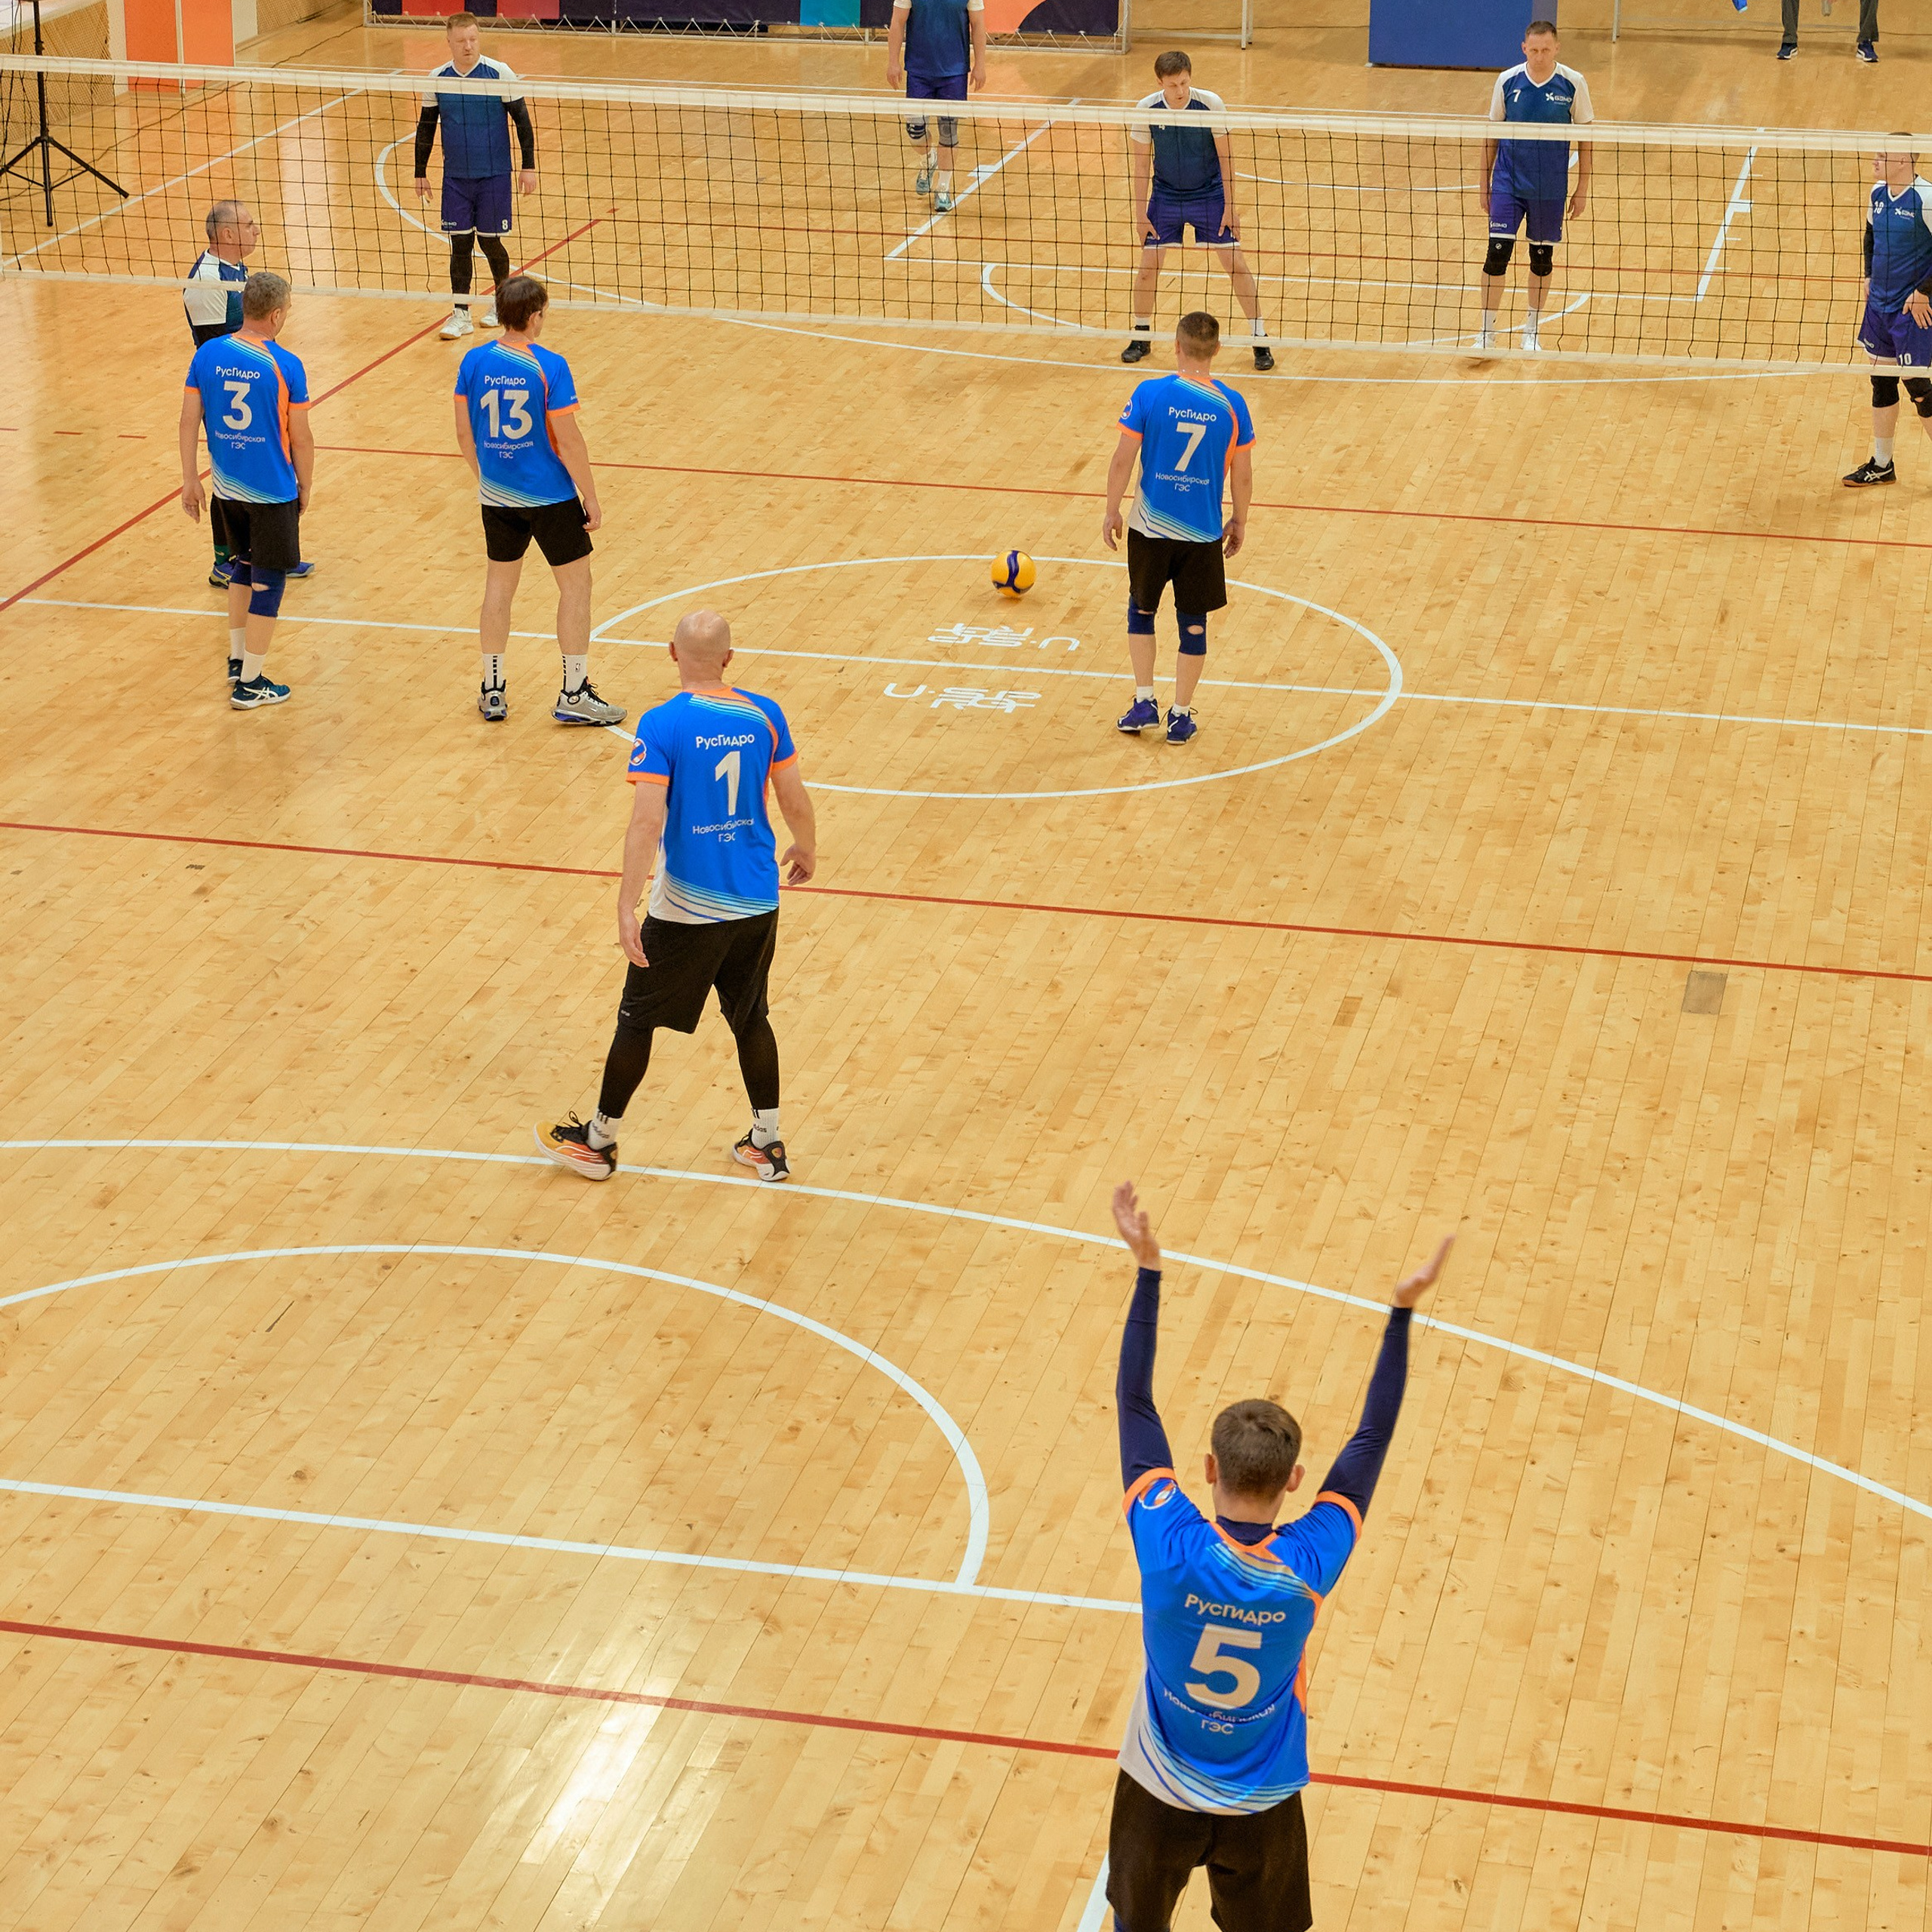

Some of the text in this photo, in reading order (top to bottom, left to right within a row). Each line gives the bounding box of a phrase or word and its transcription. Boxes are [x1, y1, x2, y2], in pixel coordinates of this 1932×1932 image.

[1512, 89, 1521, 103] 7
[501, 219, 509, 230] 8
[1899, 352, 1912, 366] 10
[215, 366, 260, 380] РусГидро
[485, 375, 526, 386] РусГидро
[223, 380, 252, 430] 3
[480, 389, 533, 439] 13
[1168, 406, 1217, 422] РусГидро
[231, 441, 246, 450] ГЭС
[1174, 421, 1207, 472] 7
[1174, 483, 1190, 492] ГЭС
[695, 734, 755, 750] РусГидро
[715, 750, 740, 816] 1
[1184, 1593, 1286, 1626] РусГидро
[1184, 1623, 1263, 1709] 5
[1201, 1719, 1234, 1734] ГЭС
